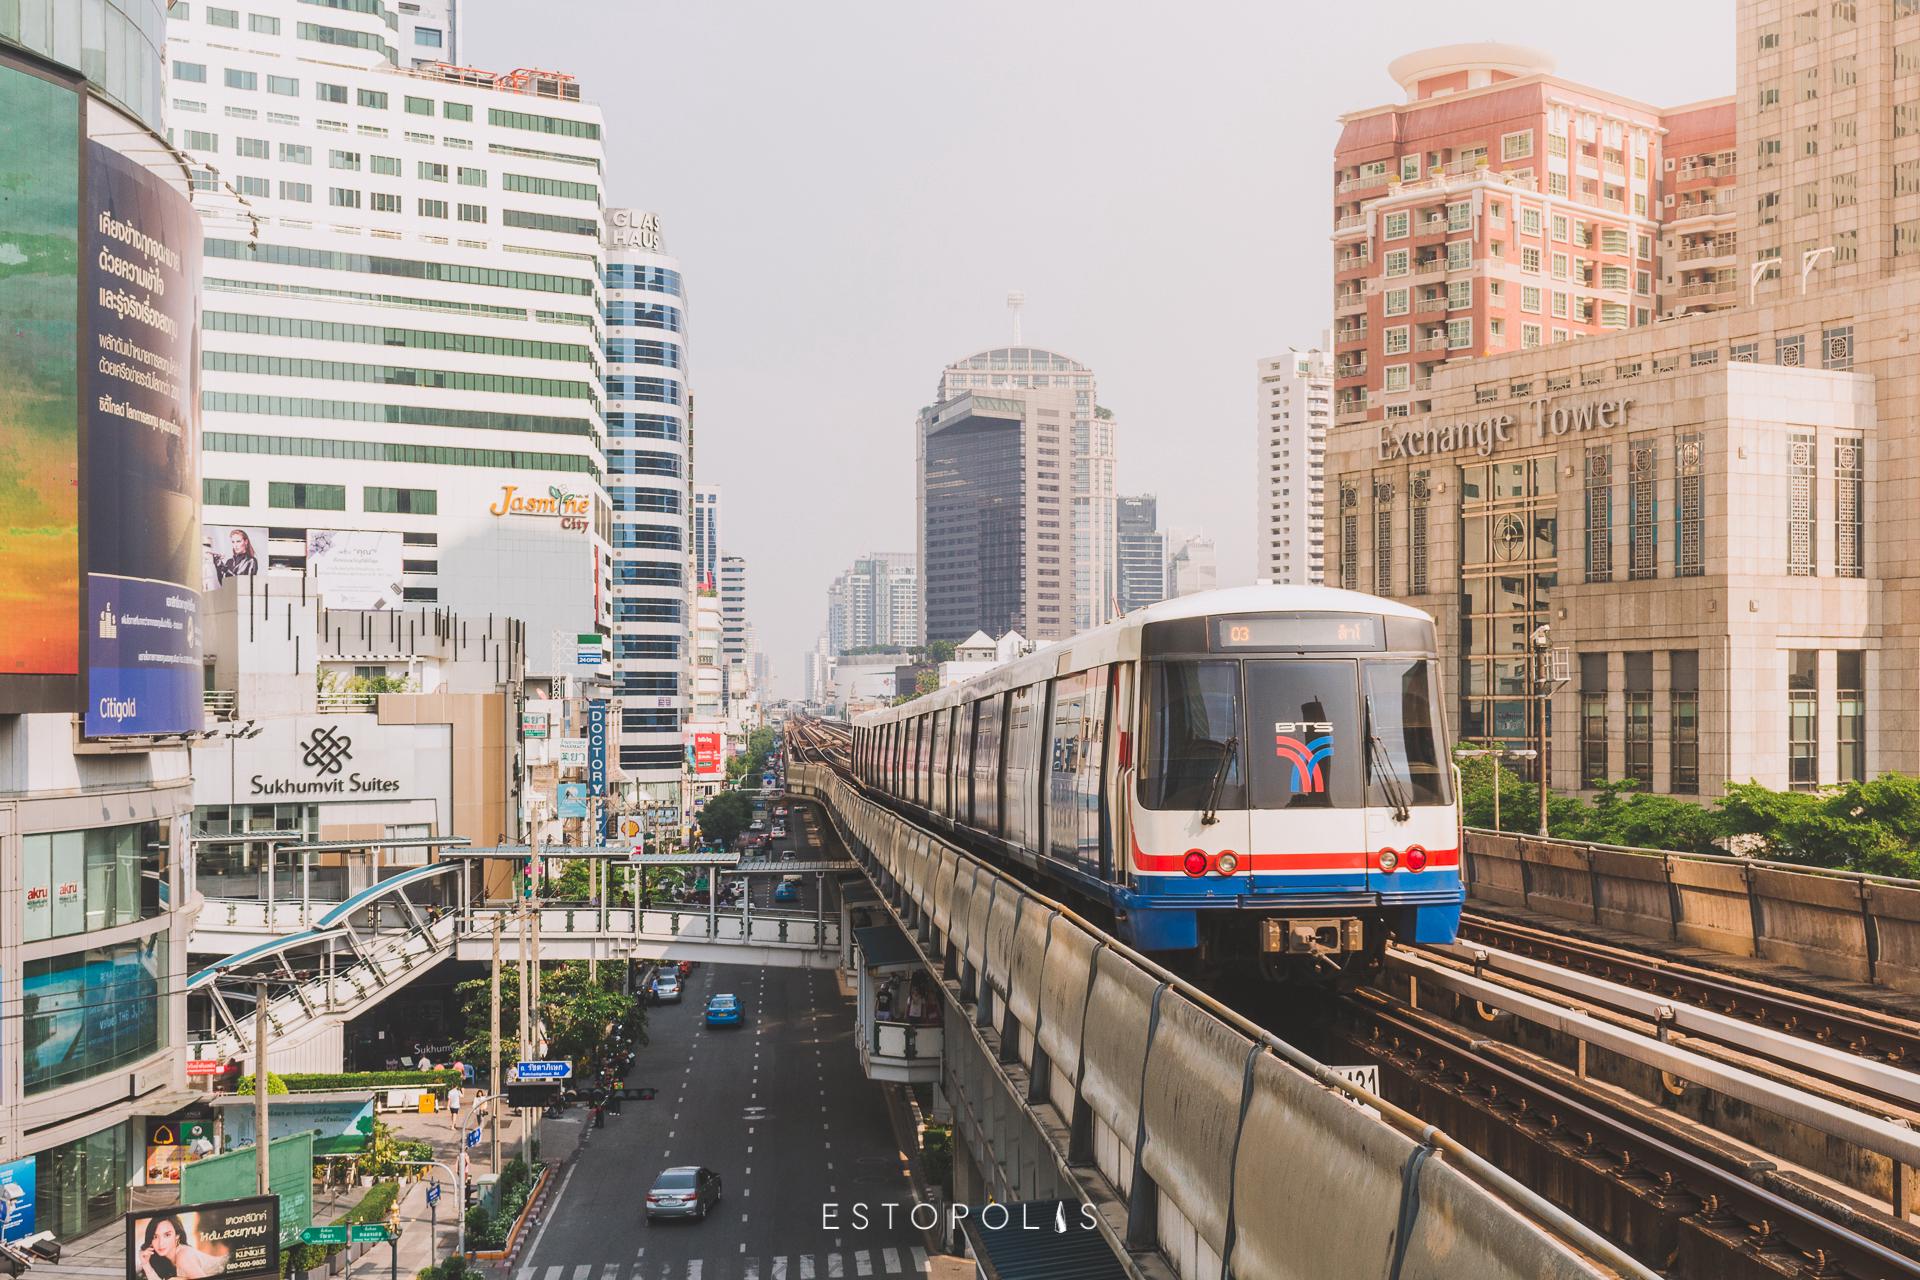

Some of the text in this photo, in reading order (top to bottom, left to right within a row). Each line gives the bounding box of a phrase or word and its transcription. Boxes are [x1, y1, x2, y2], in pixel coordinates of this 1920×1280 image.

[612, 229, 659, 249] HAUS
[1377, 398, 1634, 461] Exchange Tower
[490, 485, 590, 516] Jasmine
[561, 517, 589, 534] City
[1231, 626, 1249, 641] 03
[100, 697, 136, 722] Citigold
[1275, 722, 1334, 733] BTS
[250, 772, 400, 795] Sukhumvit Suites
[414, 1043, 455, 1054] Sukhumv
